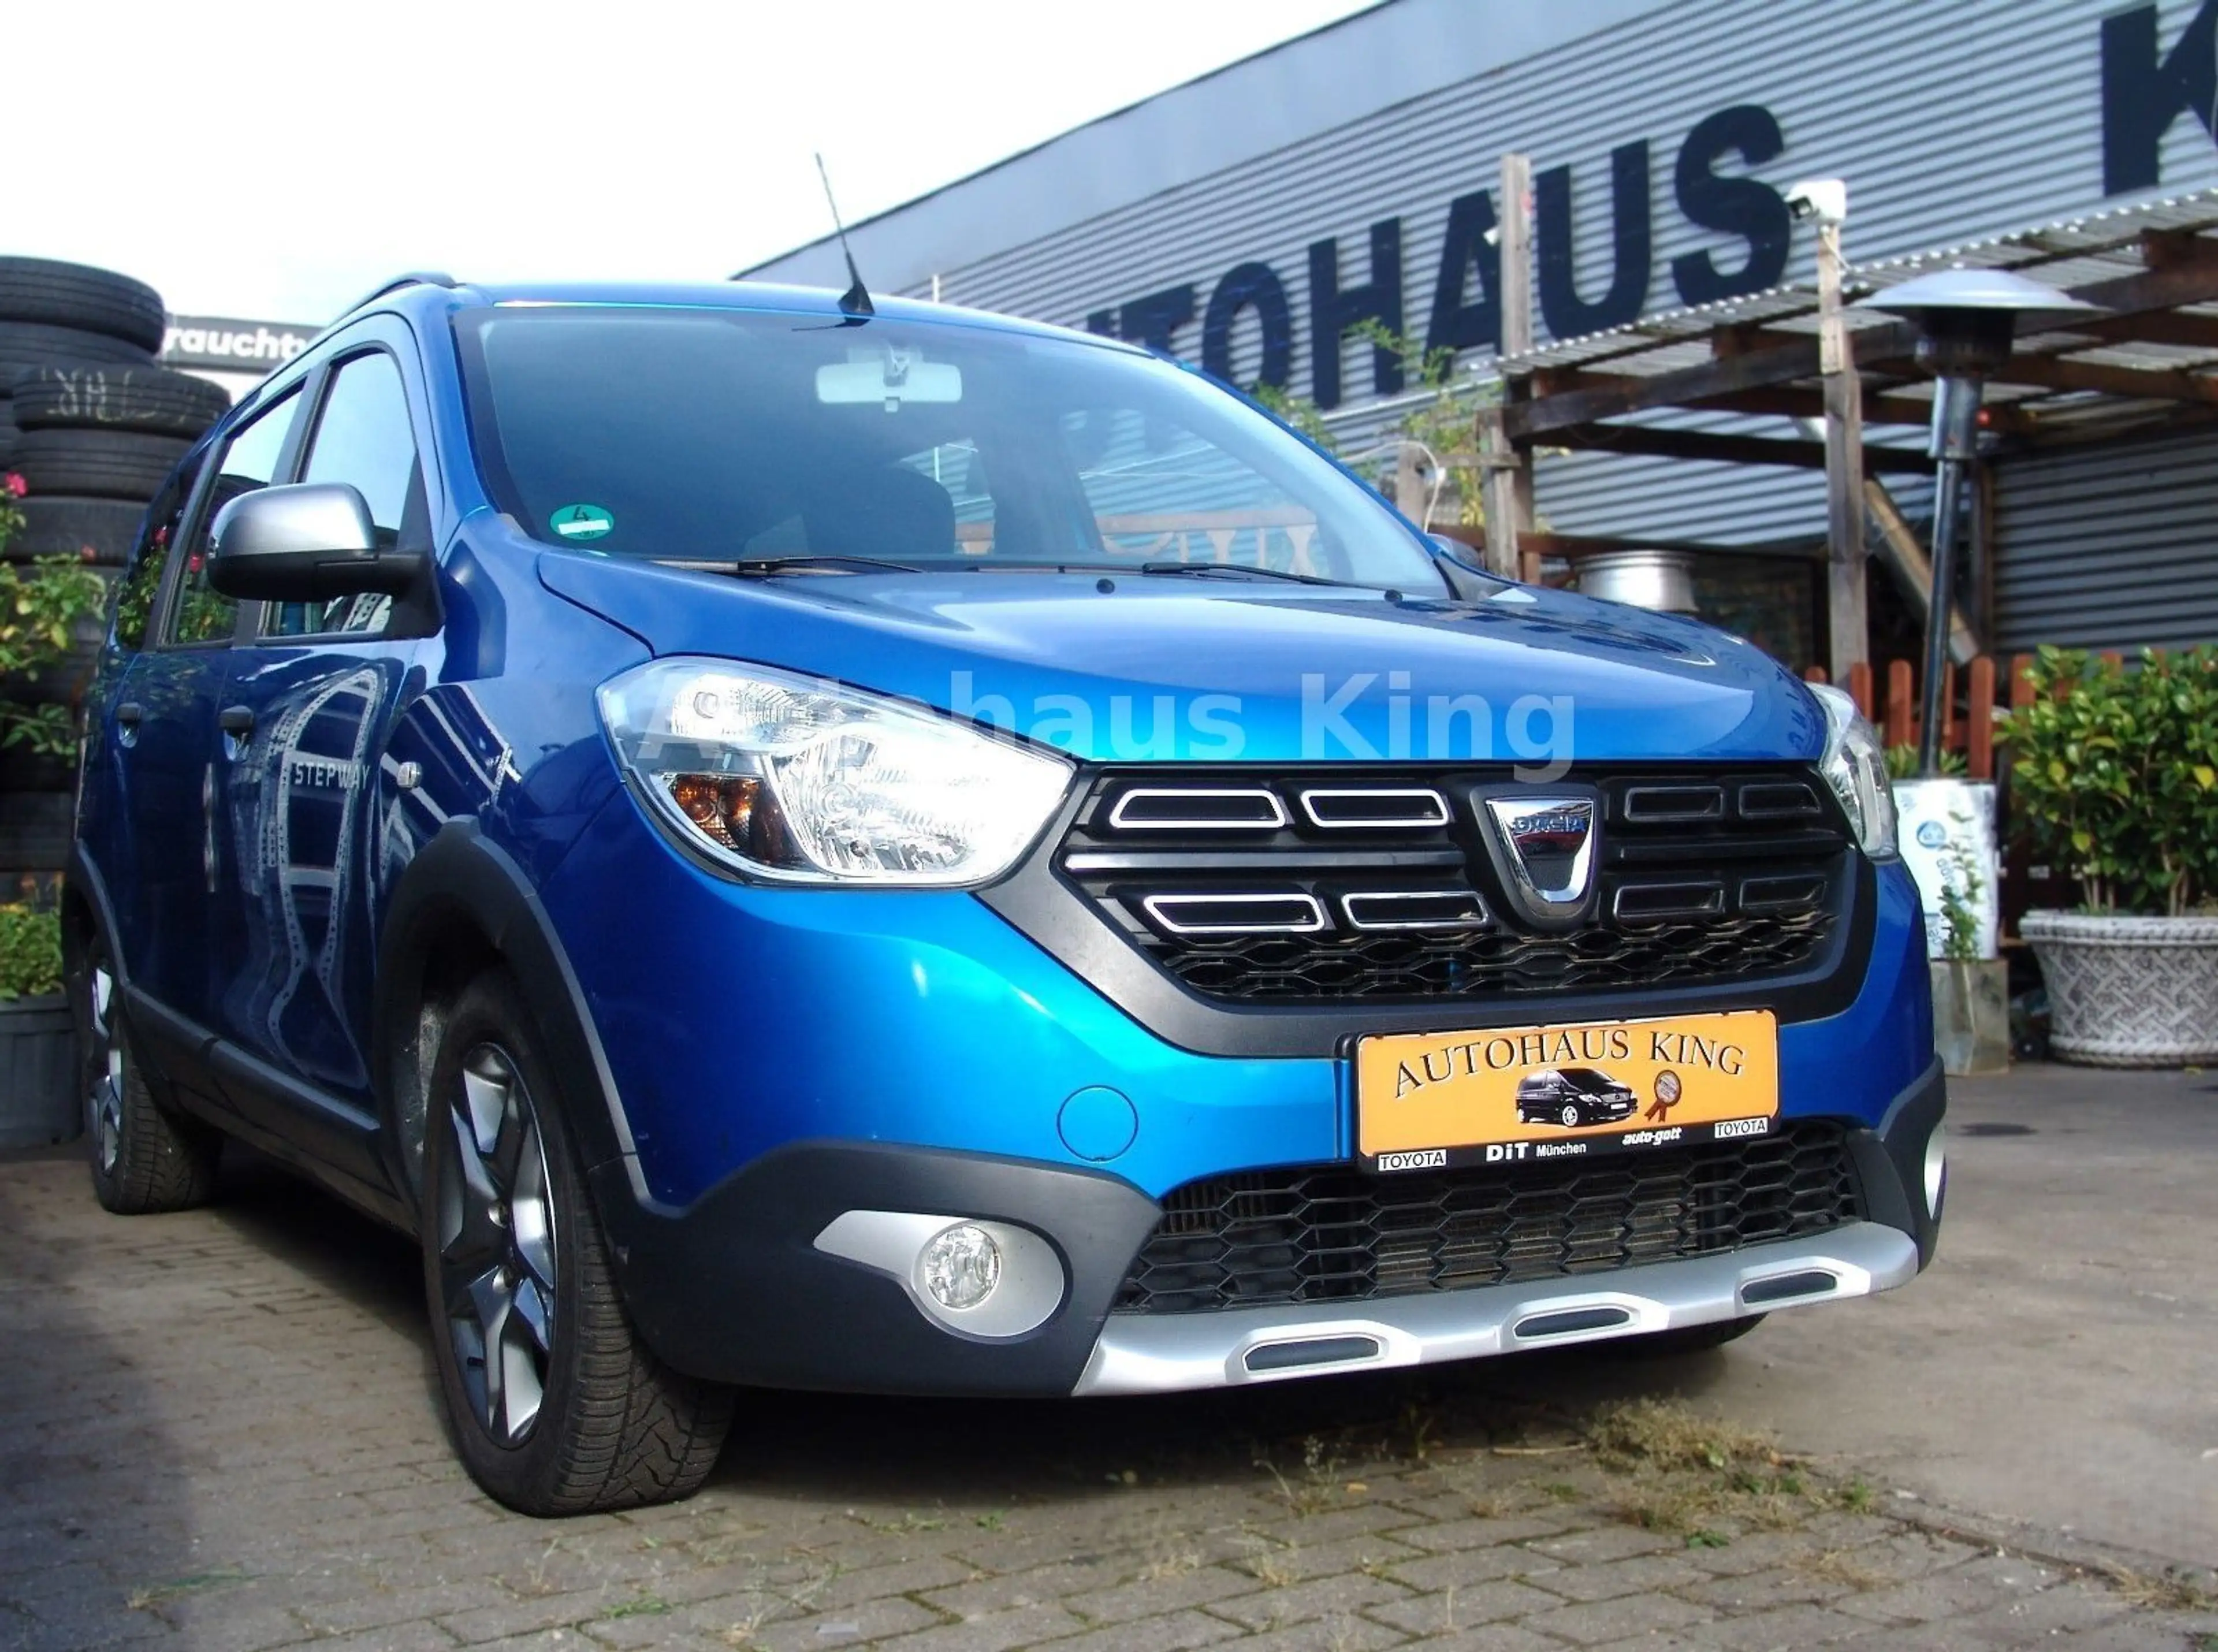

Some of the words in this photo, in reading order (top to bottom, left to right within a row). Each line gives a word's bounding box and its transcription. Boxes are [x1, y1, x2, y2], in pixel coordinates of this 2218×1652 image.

[1087, 105, 1791, 409] TOHAUS
[295, 762, 370, 790] STEPWAY
[1512, 816, 1586, 833] DACIA
[1395, 1029, 1630, 1099] AUTOHAUS
[1650, 1030, 1746, 1076] KING
[1716, 1119, 1767, 1137] TOYOTA
[1536, 1143, 1587, 1158] München
[1380, 1151, 1445, 1170] TOYOTA
